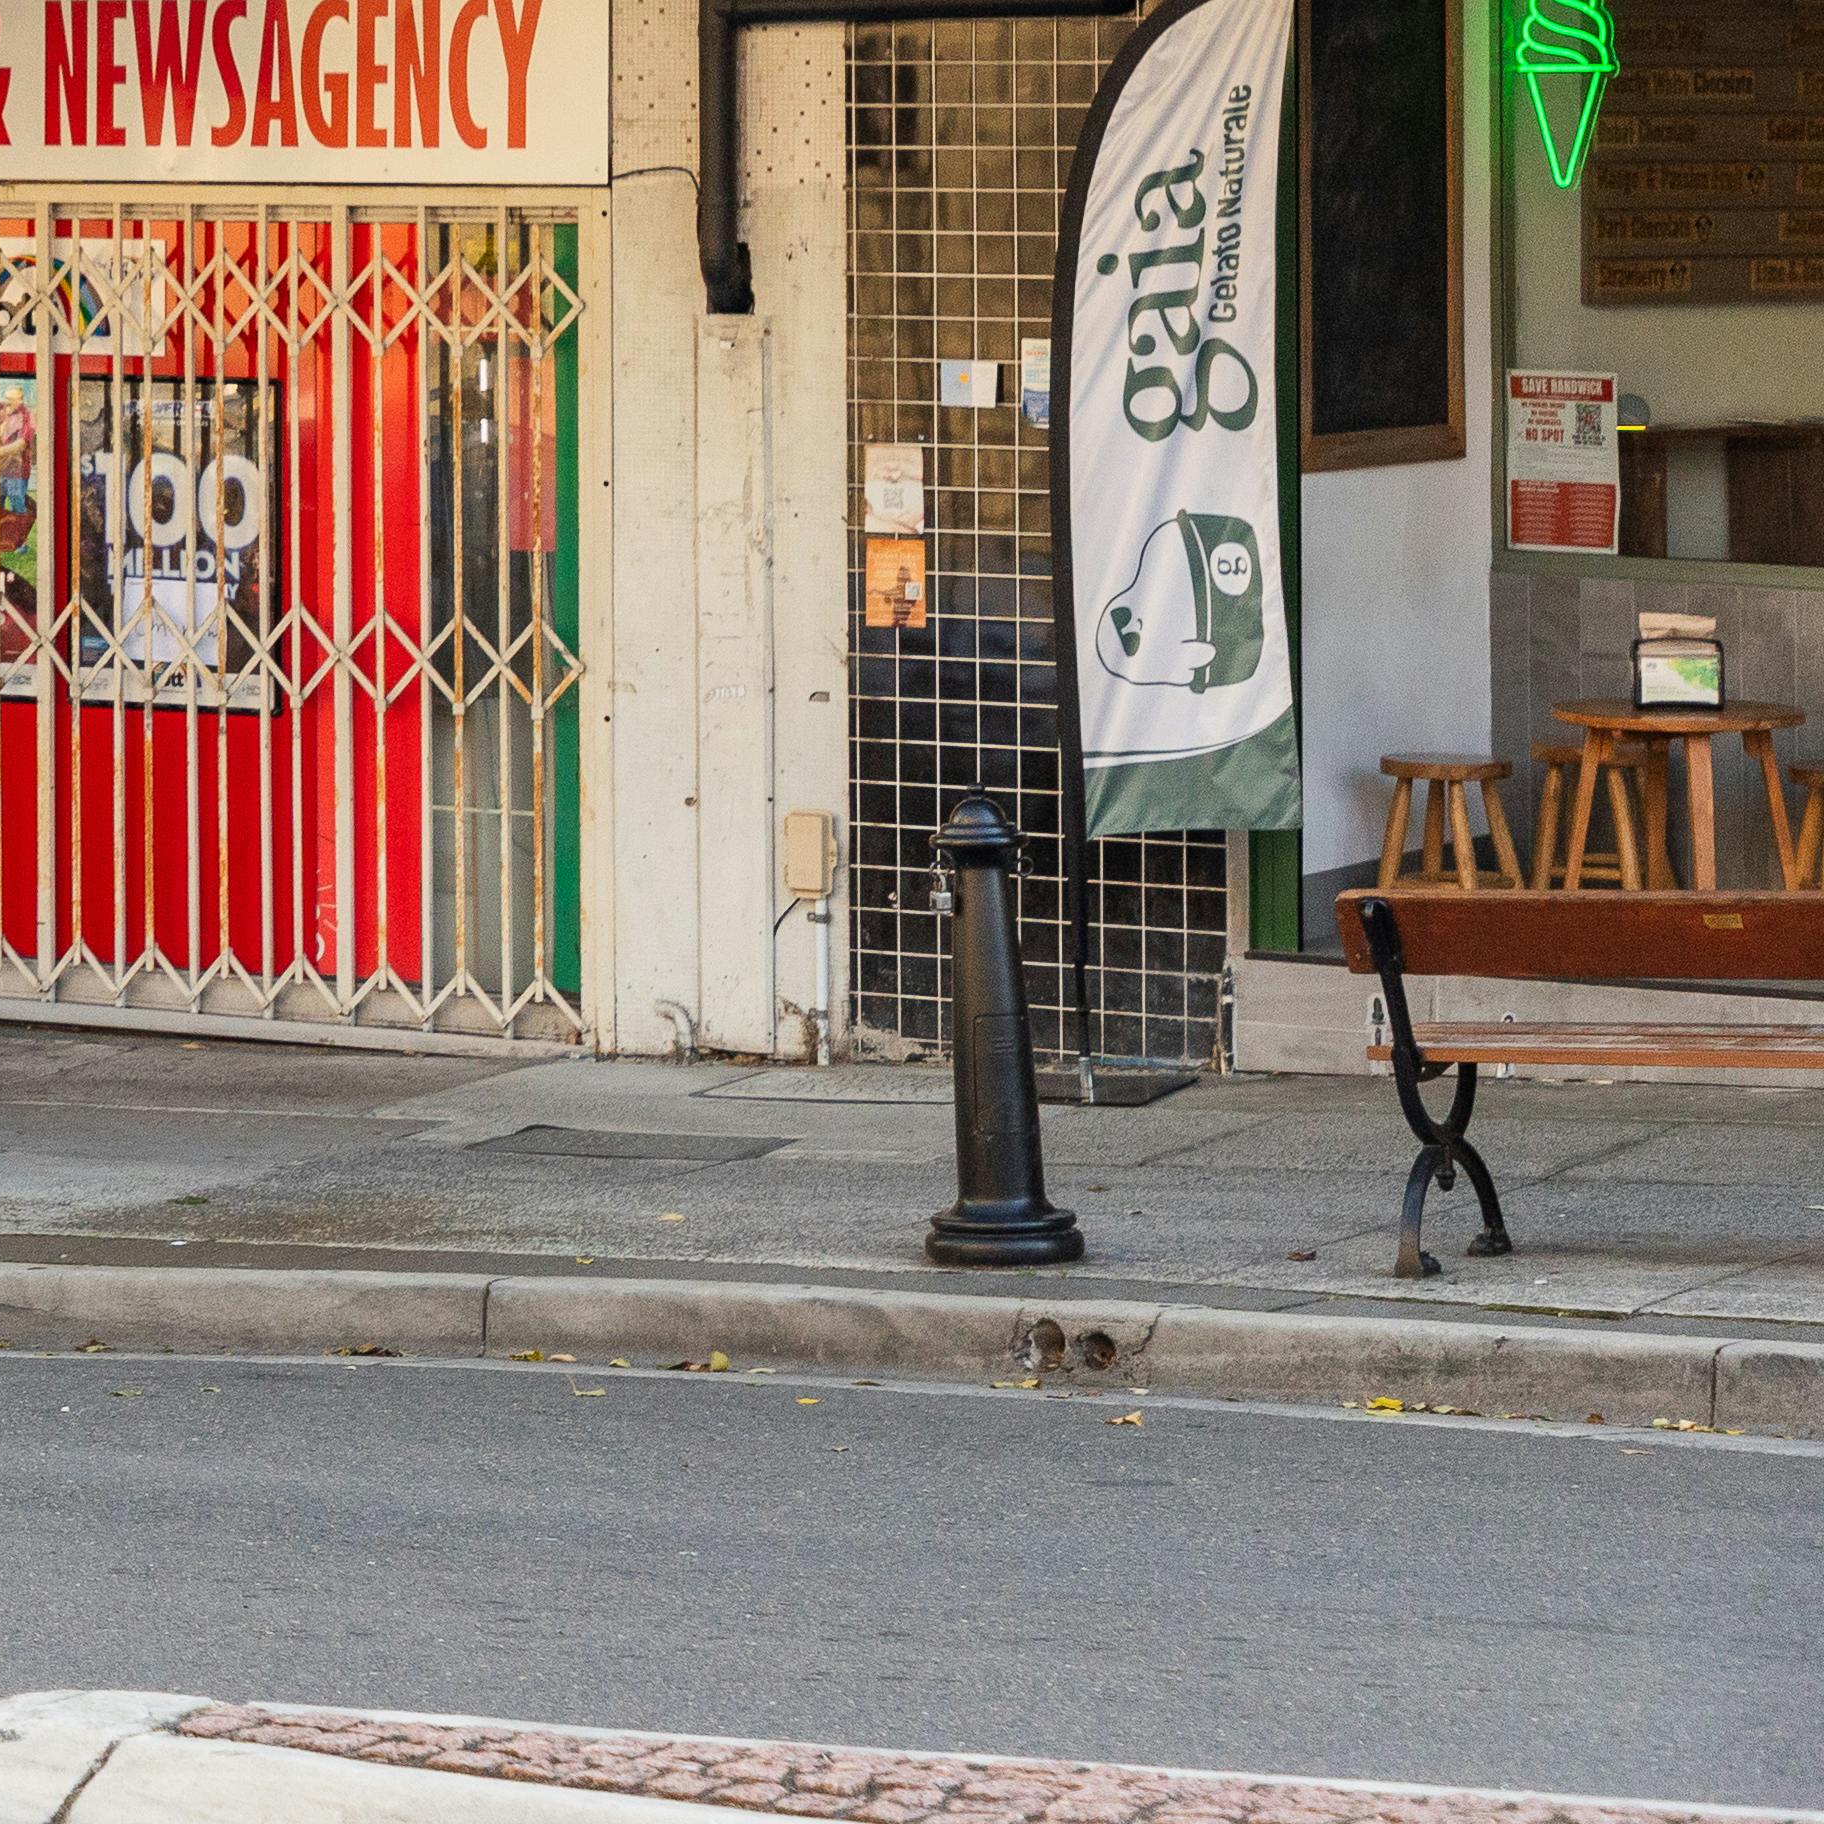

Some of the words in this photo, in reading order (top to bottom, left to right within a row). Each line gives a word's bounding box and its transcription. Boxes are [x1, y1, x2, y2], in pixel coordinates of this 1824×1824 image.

[1217, 84, 1253, 219] Naturale
[1095, 148, 1259, 443] gaia
[1208, 218, 1241, 324] Gelato
[1520, 378, 1549, 394] SAVE
